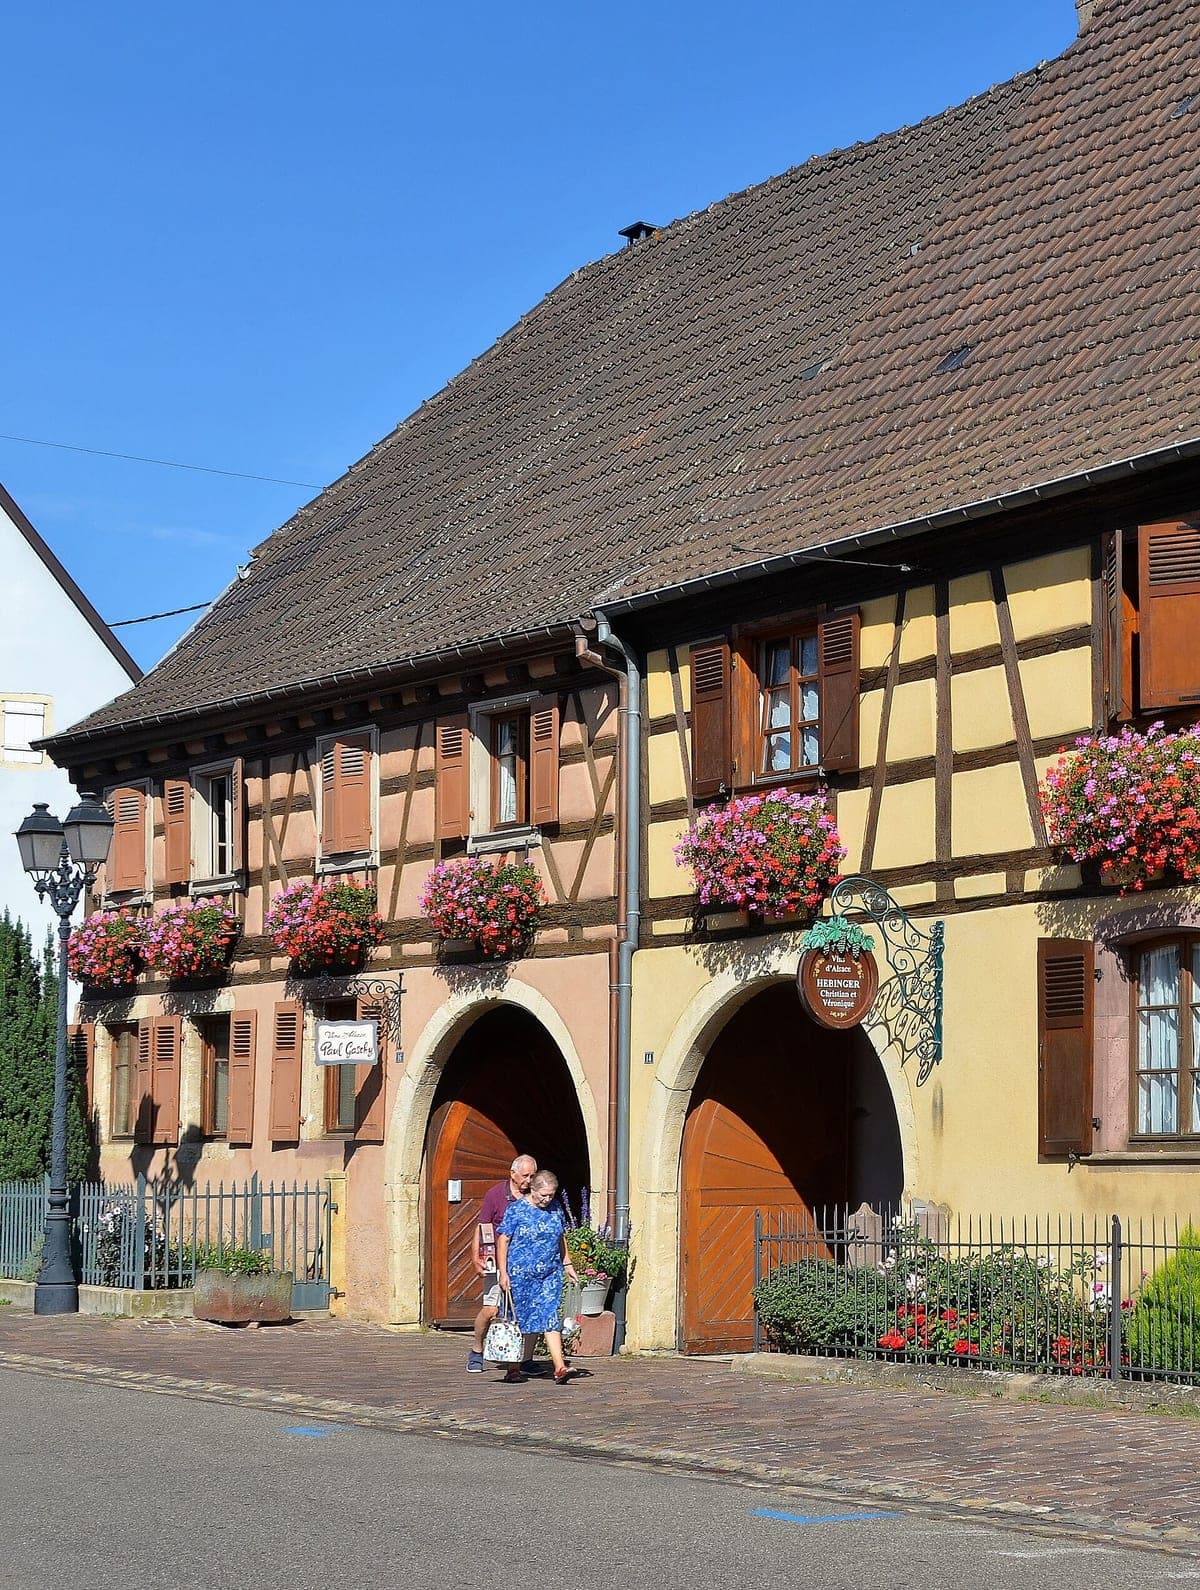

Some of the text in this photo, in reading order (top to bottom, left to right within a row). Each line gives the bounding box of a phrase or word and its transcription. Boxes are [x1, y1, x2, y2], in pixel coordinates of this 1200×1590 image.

[825, 964, 851, 973] d'Alsace
[816, 979, 860, 988] HEBINGER
[820, 989, 849, 998] Christian
[822, 999, 855, 1009] Véronique
[320, 1041, 343, 1057] Paul
